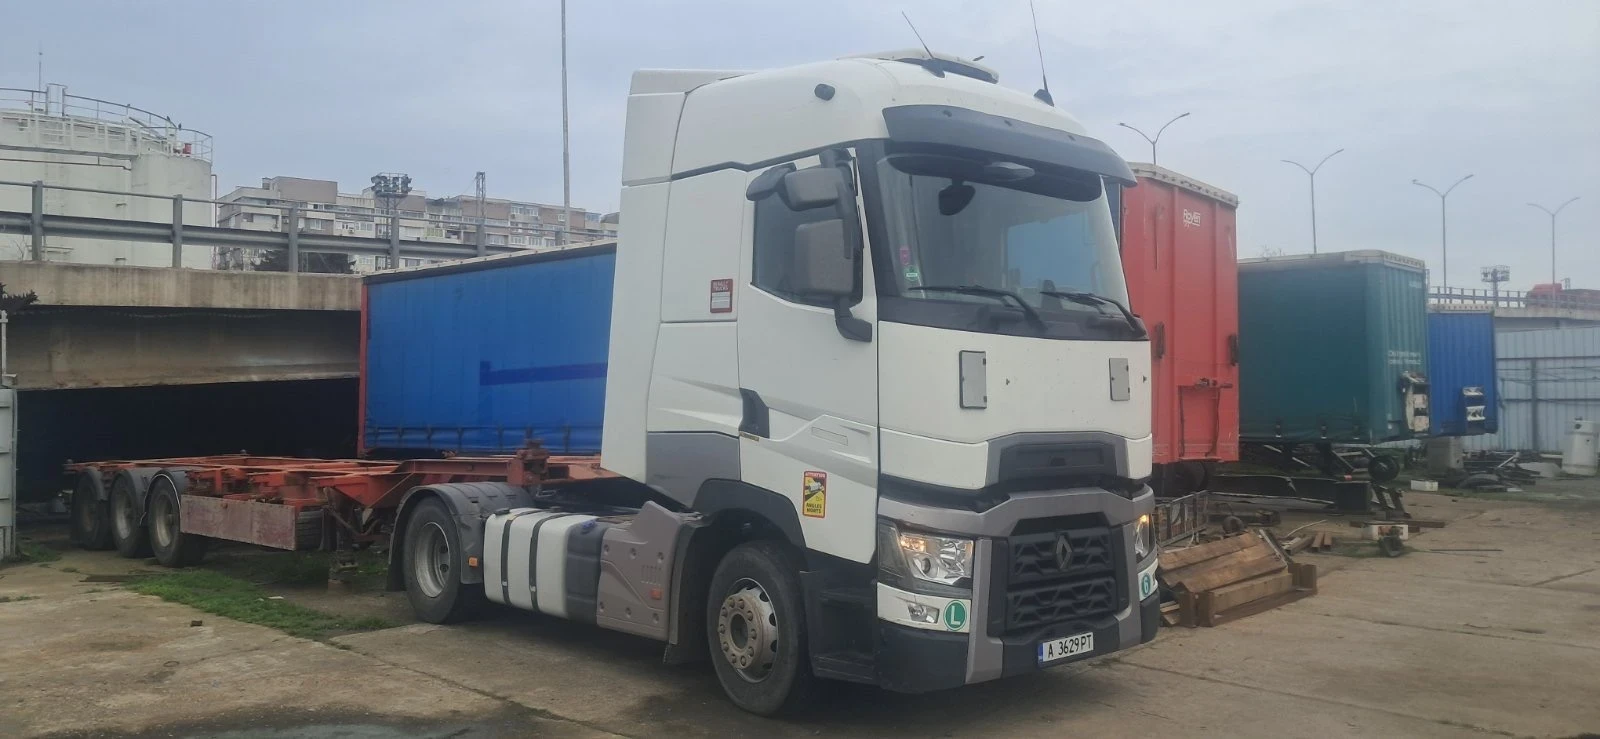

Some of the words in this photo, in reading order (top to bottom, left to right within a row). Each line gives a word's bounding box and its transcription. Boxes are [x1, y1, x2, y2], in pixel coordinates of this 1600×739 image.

[1143, 576, 1149, 594] 6
[950, 605, 961, 625] L
[1047, 643, 1054, 658] A
